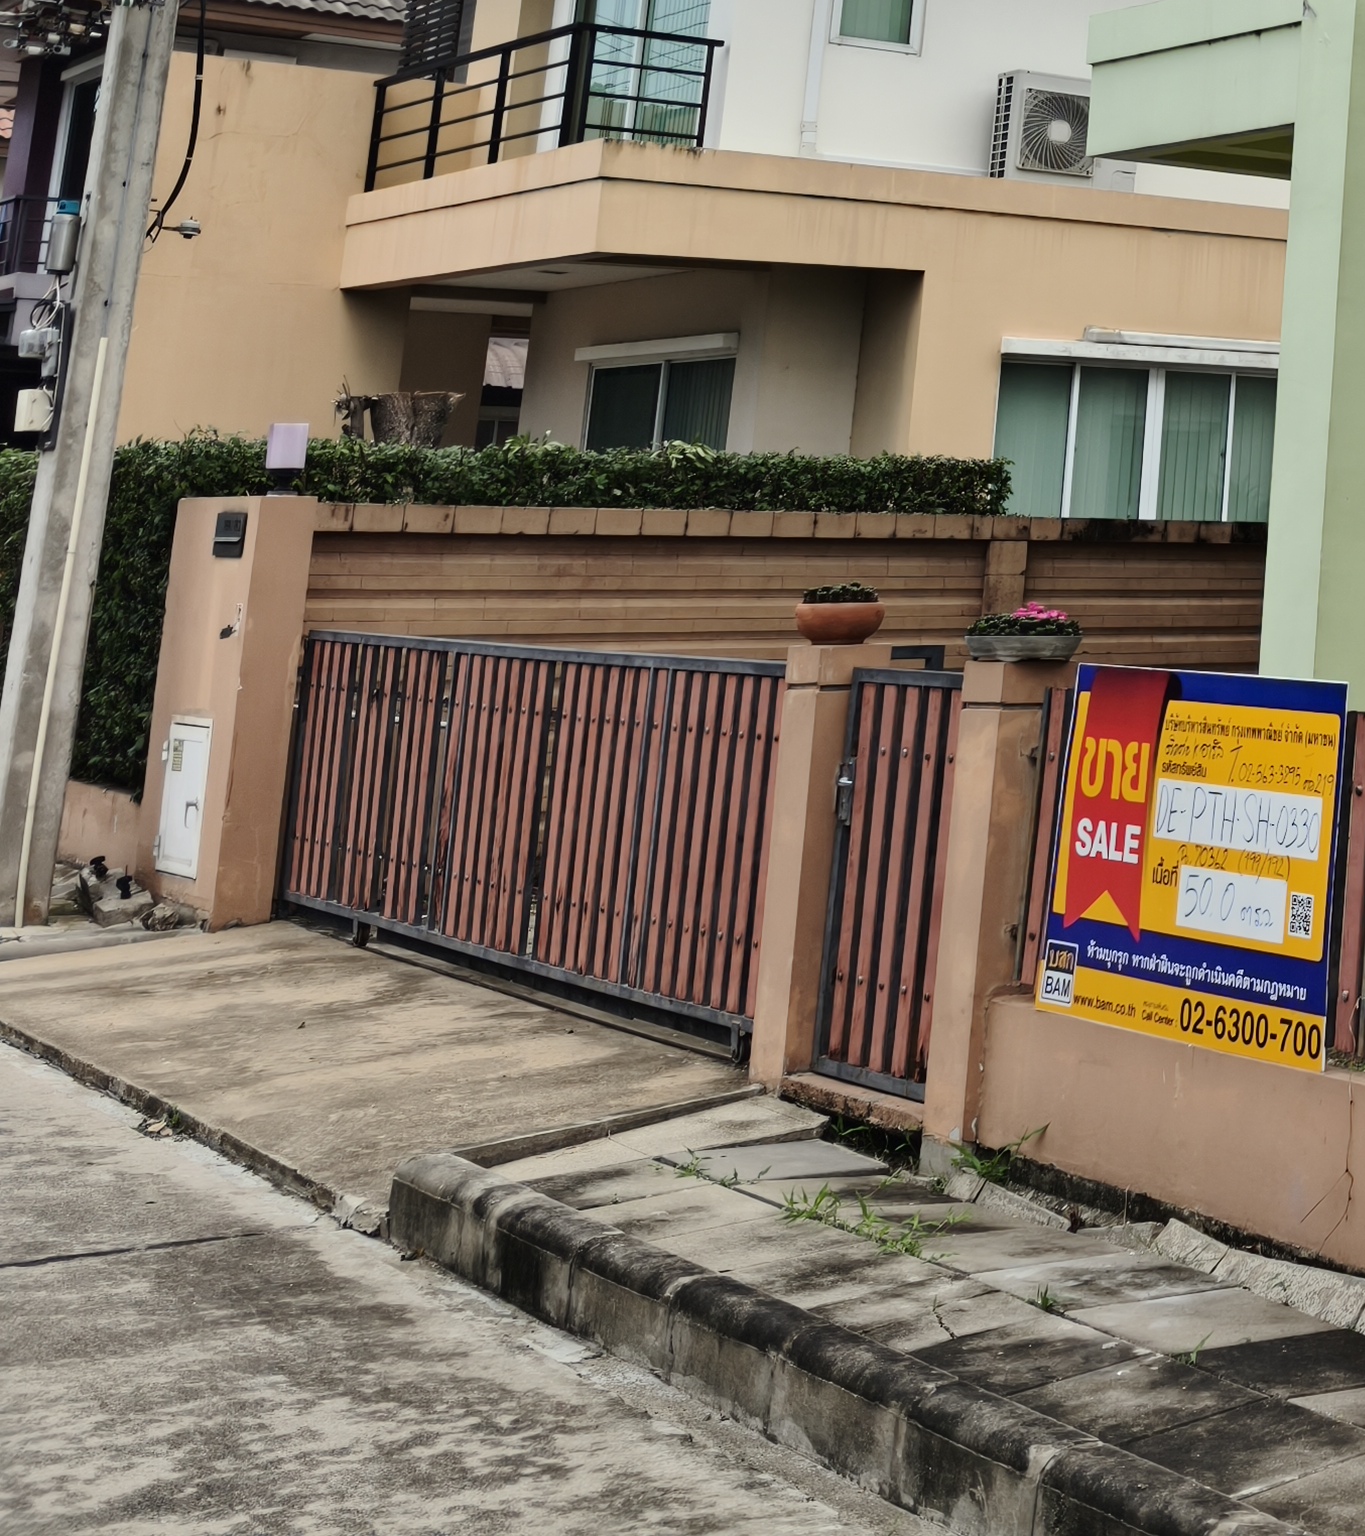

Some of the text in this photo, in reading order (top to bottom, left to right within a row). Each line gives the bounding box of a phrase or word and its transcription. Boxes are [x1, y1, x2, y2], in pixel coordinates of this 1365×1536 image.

[1304, 731, 1336, 751] (มหาชน)
[1081, 736, 1150, 803] ขาย
[1162, 759, 1207, 778] รหัสทรัพย์สิน
[1075, 817, 1141, 864] SALE
[1152, 856, 1179, 888] เนื้อที่
[1048, 949, 1074, 971] บสก
[1087, 939, 1129, 971] ห้ามบุกรุก
[1044, 975, 1071, 998] BAM
[1073, 994, 1136, 1018] www.bam.co.th
[1180, 998, 1321, 1060] 02-6300-700
